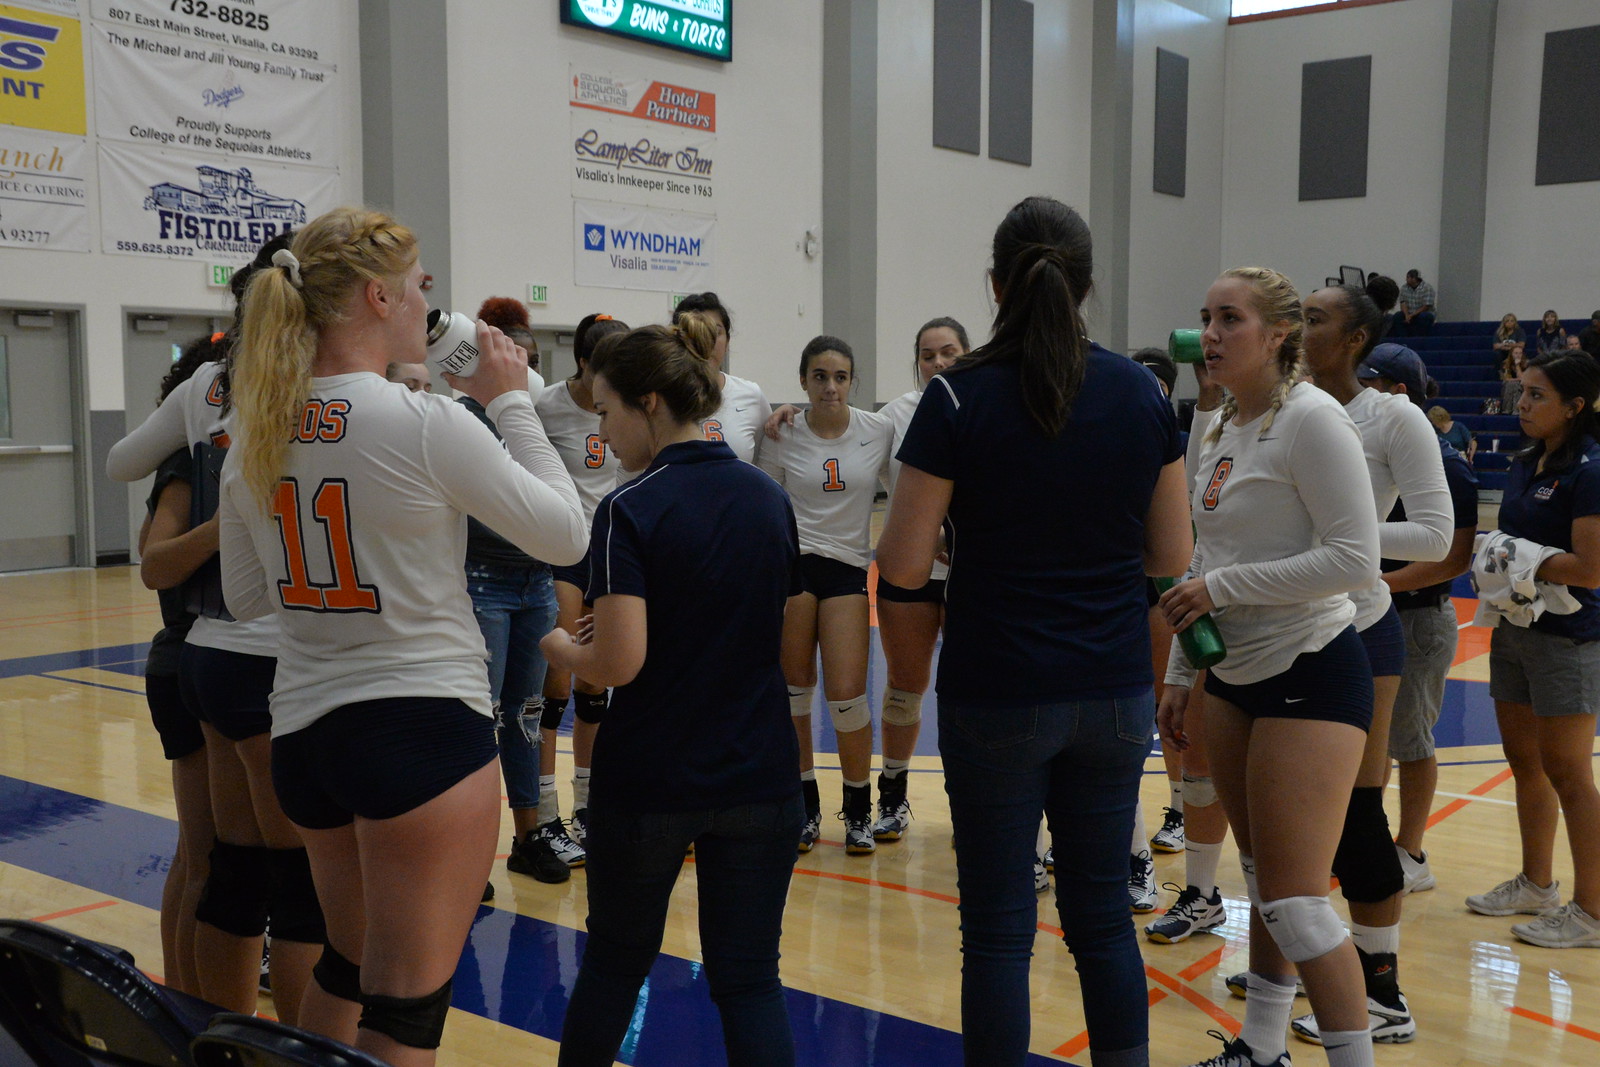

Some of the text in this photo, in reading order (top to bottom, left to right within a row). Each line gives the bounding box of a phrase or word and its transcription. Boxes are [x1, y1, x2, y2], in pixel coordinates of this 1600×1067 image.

[109, 8, 319, 60] 807 East Main Street, Visalia, CA 93292
[629, 3, 670, 35] BUNS
[681, 18, 726, 51] TORTS
[107, 31, 325, 82] The Michael and Jill Young Family Trust
[579, 72, 613, 87] COLLEGE
[579, 81, 628, 98] SEQUOIAS
[202, 84, 245, 108] Dodgers
[580, 90, 628, 107] ATHLETICS
[660, 86, 700, 109] Hotel
[176, 116, 272, 141] Proudly Supports
[646, 100, 711, 129] Partners
[129, 125, 312, 160] College of the Sequoias Athletics
[675, 147, 713, 175] Inn
[24, 182, 85, 198] CATERING
[576, 167, 712, 197] Visalia's Innkeeper Since 1963
[11, 228, 50, 244] 93277
[117, 240, 194, 256] 559.625.8372
[610, 228, 701, 257] WYNDHAM
[610, 254, 647, 271] Visalia
[532, 285, 547, 302] EXIT
[585, 434, 605, 469] 9
[823, 458, 845, 492] 1
[1202, 457, 1233, 511] 8
[273, 477, 382, 614] 11
